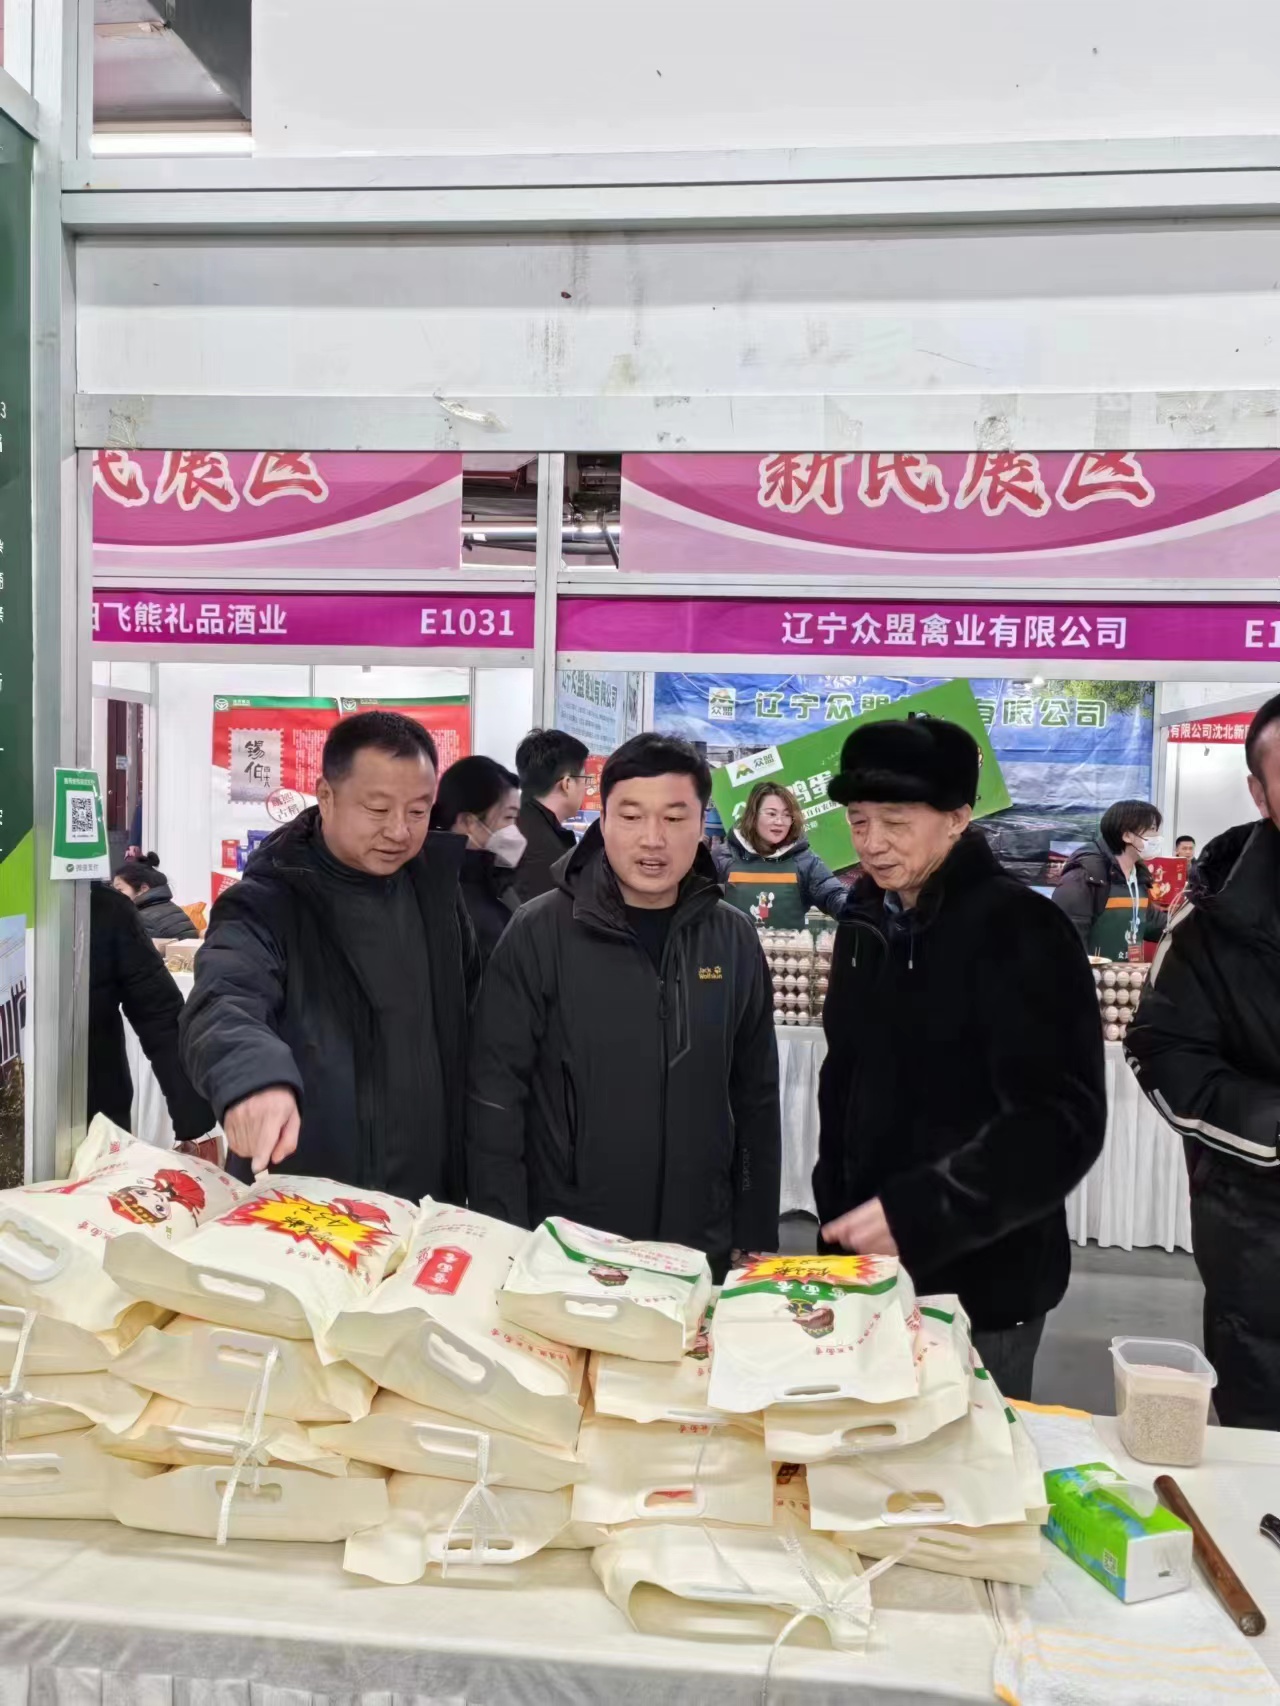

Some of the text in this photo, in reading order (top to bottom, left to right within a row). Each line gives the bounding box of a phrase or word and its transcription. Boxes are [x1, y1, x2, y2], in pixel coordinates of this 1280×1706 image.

[420, 608, 515, 636] E1031
[781, 612, 1128, 649] 辽宁众盟禽业有限公司
[1167, 722, 1251, 740] 有限公司沈北新
